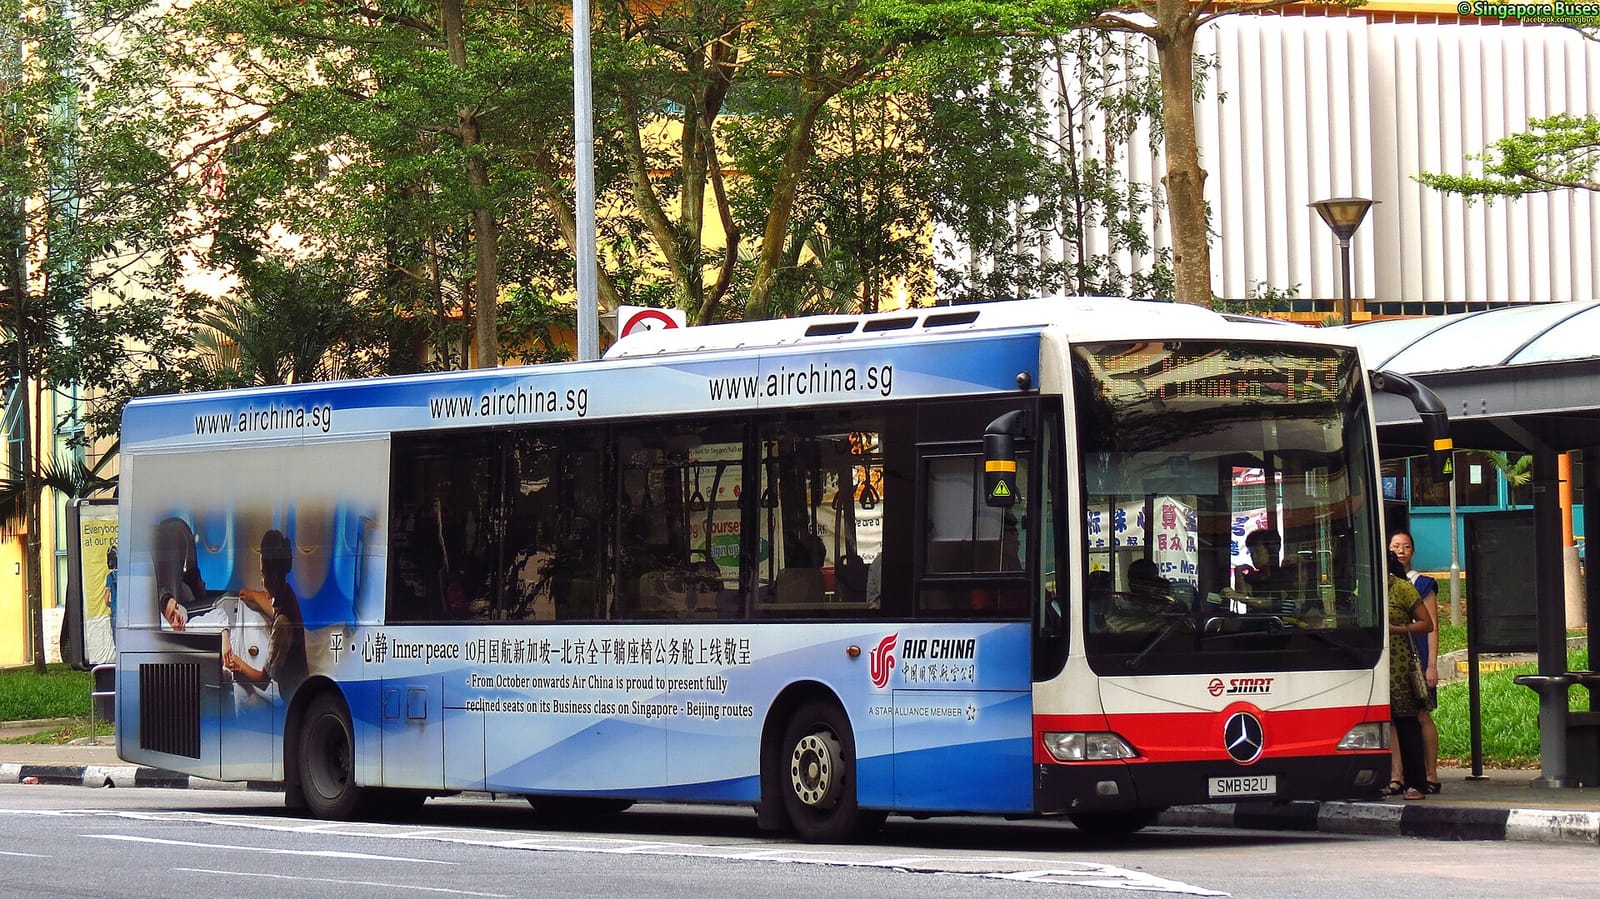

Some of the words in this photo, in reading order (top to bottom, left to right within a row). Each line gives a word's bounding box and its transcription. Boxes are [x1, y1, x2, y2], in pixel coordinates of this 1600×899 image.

[709, 362, 893, 401] www.airchina.sg
[1285, 357, 1339, 400] 173
[430, 385, 588, 418] www.airchina.sg
[195, 403, 332, 434] www.airchina.sg
[95, 538, 107, 546] our
[392, 639, 424, 659] Inner
[425, 643, 459, 664] peace
[902, 639, 928, 659] AIR
[930, 639, 976, 659] CHINA
[472, 674, 494, 687] From
[496, 674, 530, 688] October
[532, 674, 570, 689] onwards
[572, 675, 586, 689] Air
[588, 675, 614, 689] China
[616, 676, 624, 689] is
[626, 675, 654, 693] proud
[656, 677, 665, 690] to
[668, 677, 704, 693] present
[706, 675, 727, 694] fully
[1226, 678, 1275, 694] SMRT
[466, 698, 500, 712] reclined
[503, 701, 525, 713] seats
[526, 702, 538, 713] on
[540, 699, 551, 713] its
[553, 700, 592, 714] Business
[594, 700, 616, 715] class
[618, 702, 629, 715] on
[631, 701, 678, 719] Singapore
[687, 702, 720, 720] Beijing
[722, 703, 753, 717] routes
[868, 707, 874, 715] A
[875, 707, 893, 715] STAR
[895, 707, 929, 716] ALLIANCE
[930, 708, 962, 716] MEMBER
[1217, 778, 1268, 793] SMB92U
